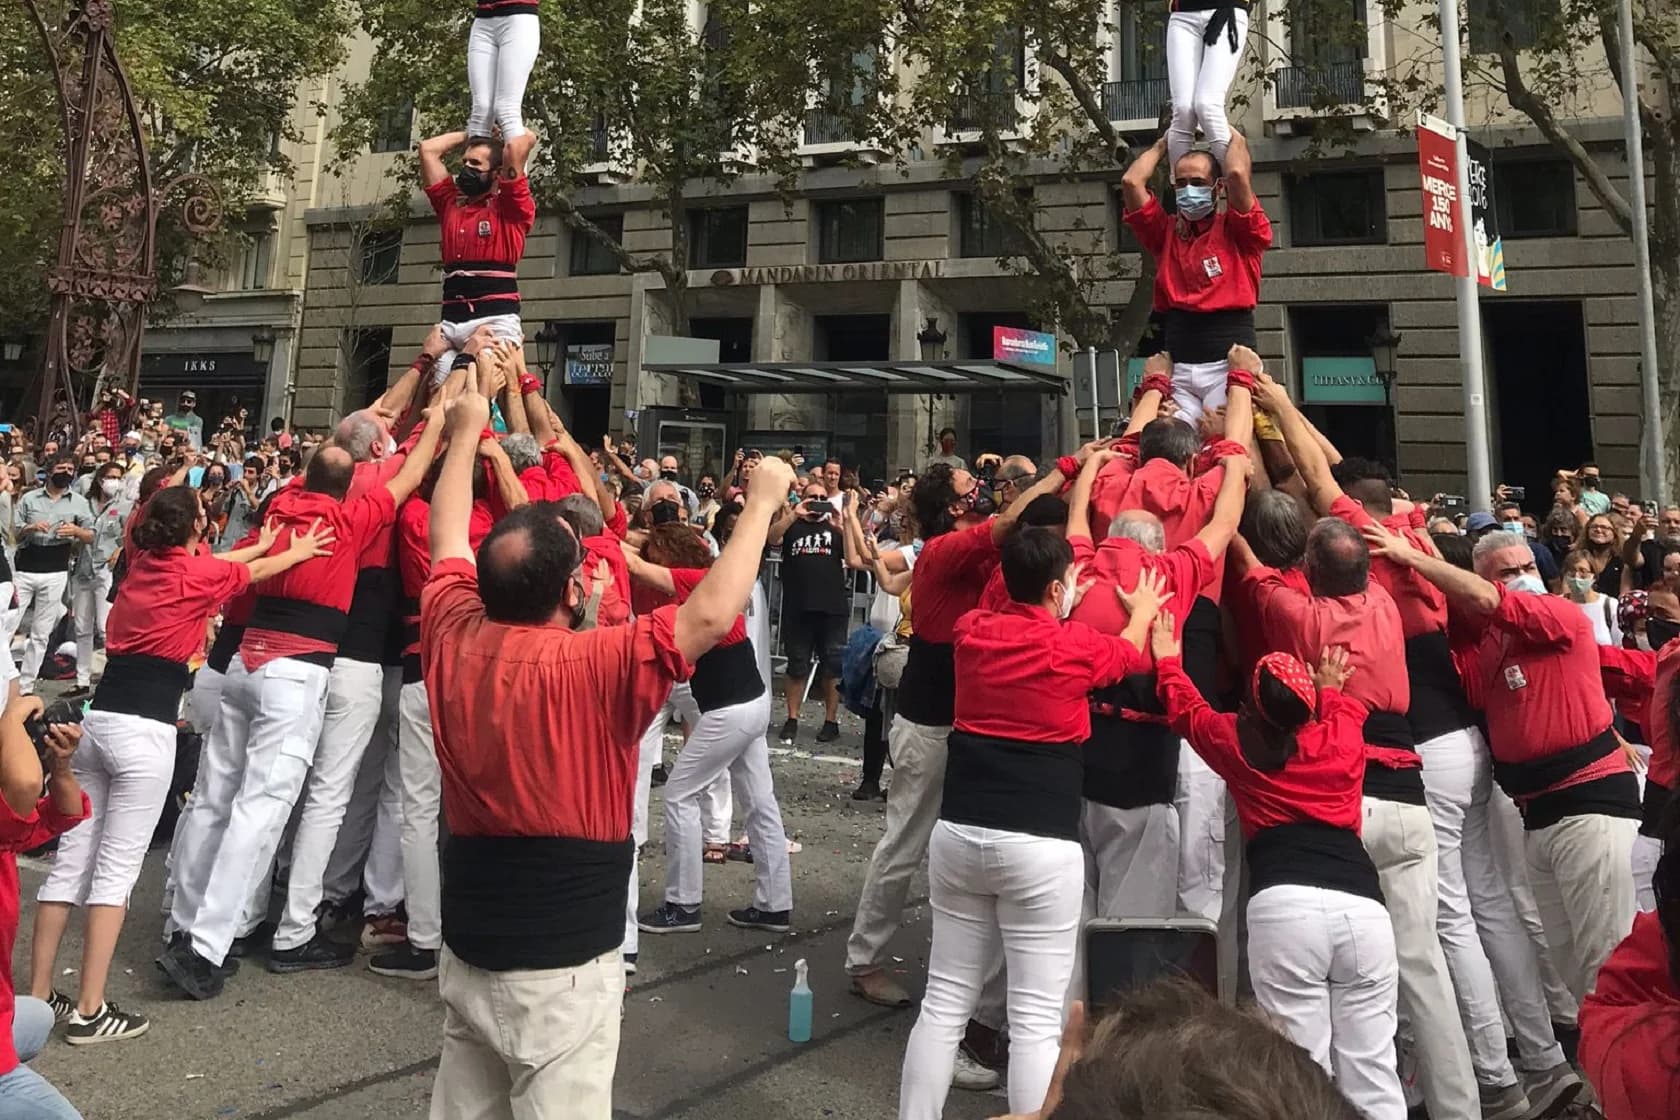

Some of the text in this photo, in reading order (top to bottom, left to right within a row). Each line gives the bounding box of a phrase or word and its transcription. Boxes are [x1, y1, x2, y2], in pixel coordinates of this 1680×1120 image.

[1432, 195, 1451, 215] 150
[740, 261, 944, 284] MANDARIN ORIENTAL
[184, 360, 216, 371] IKKS
